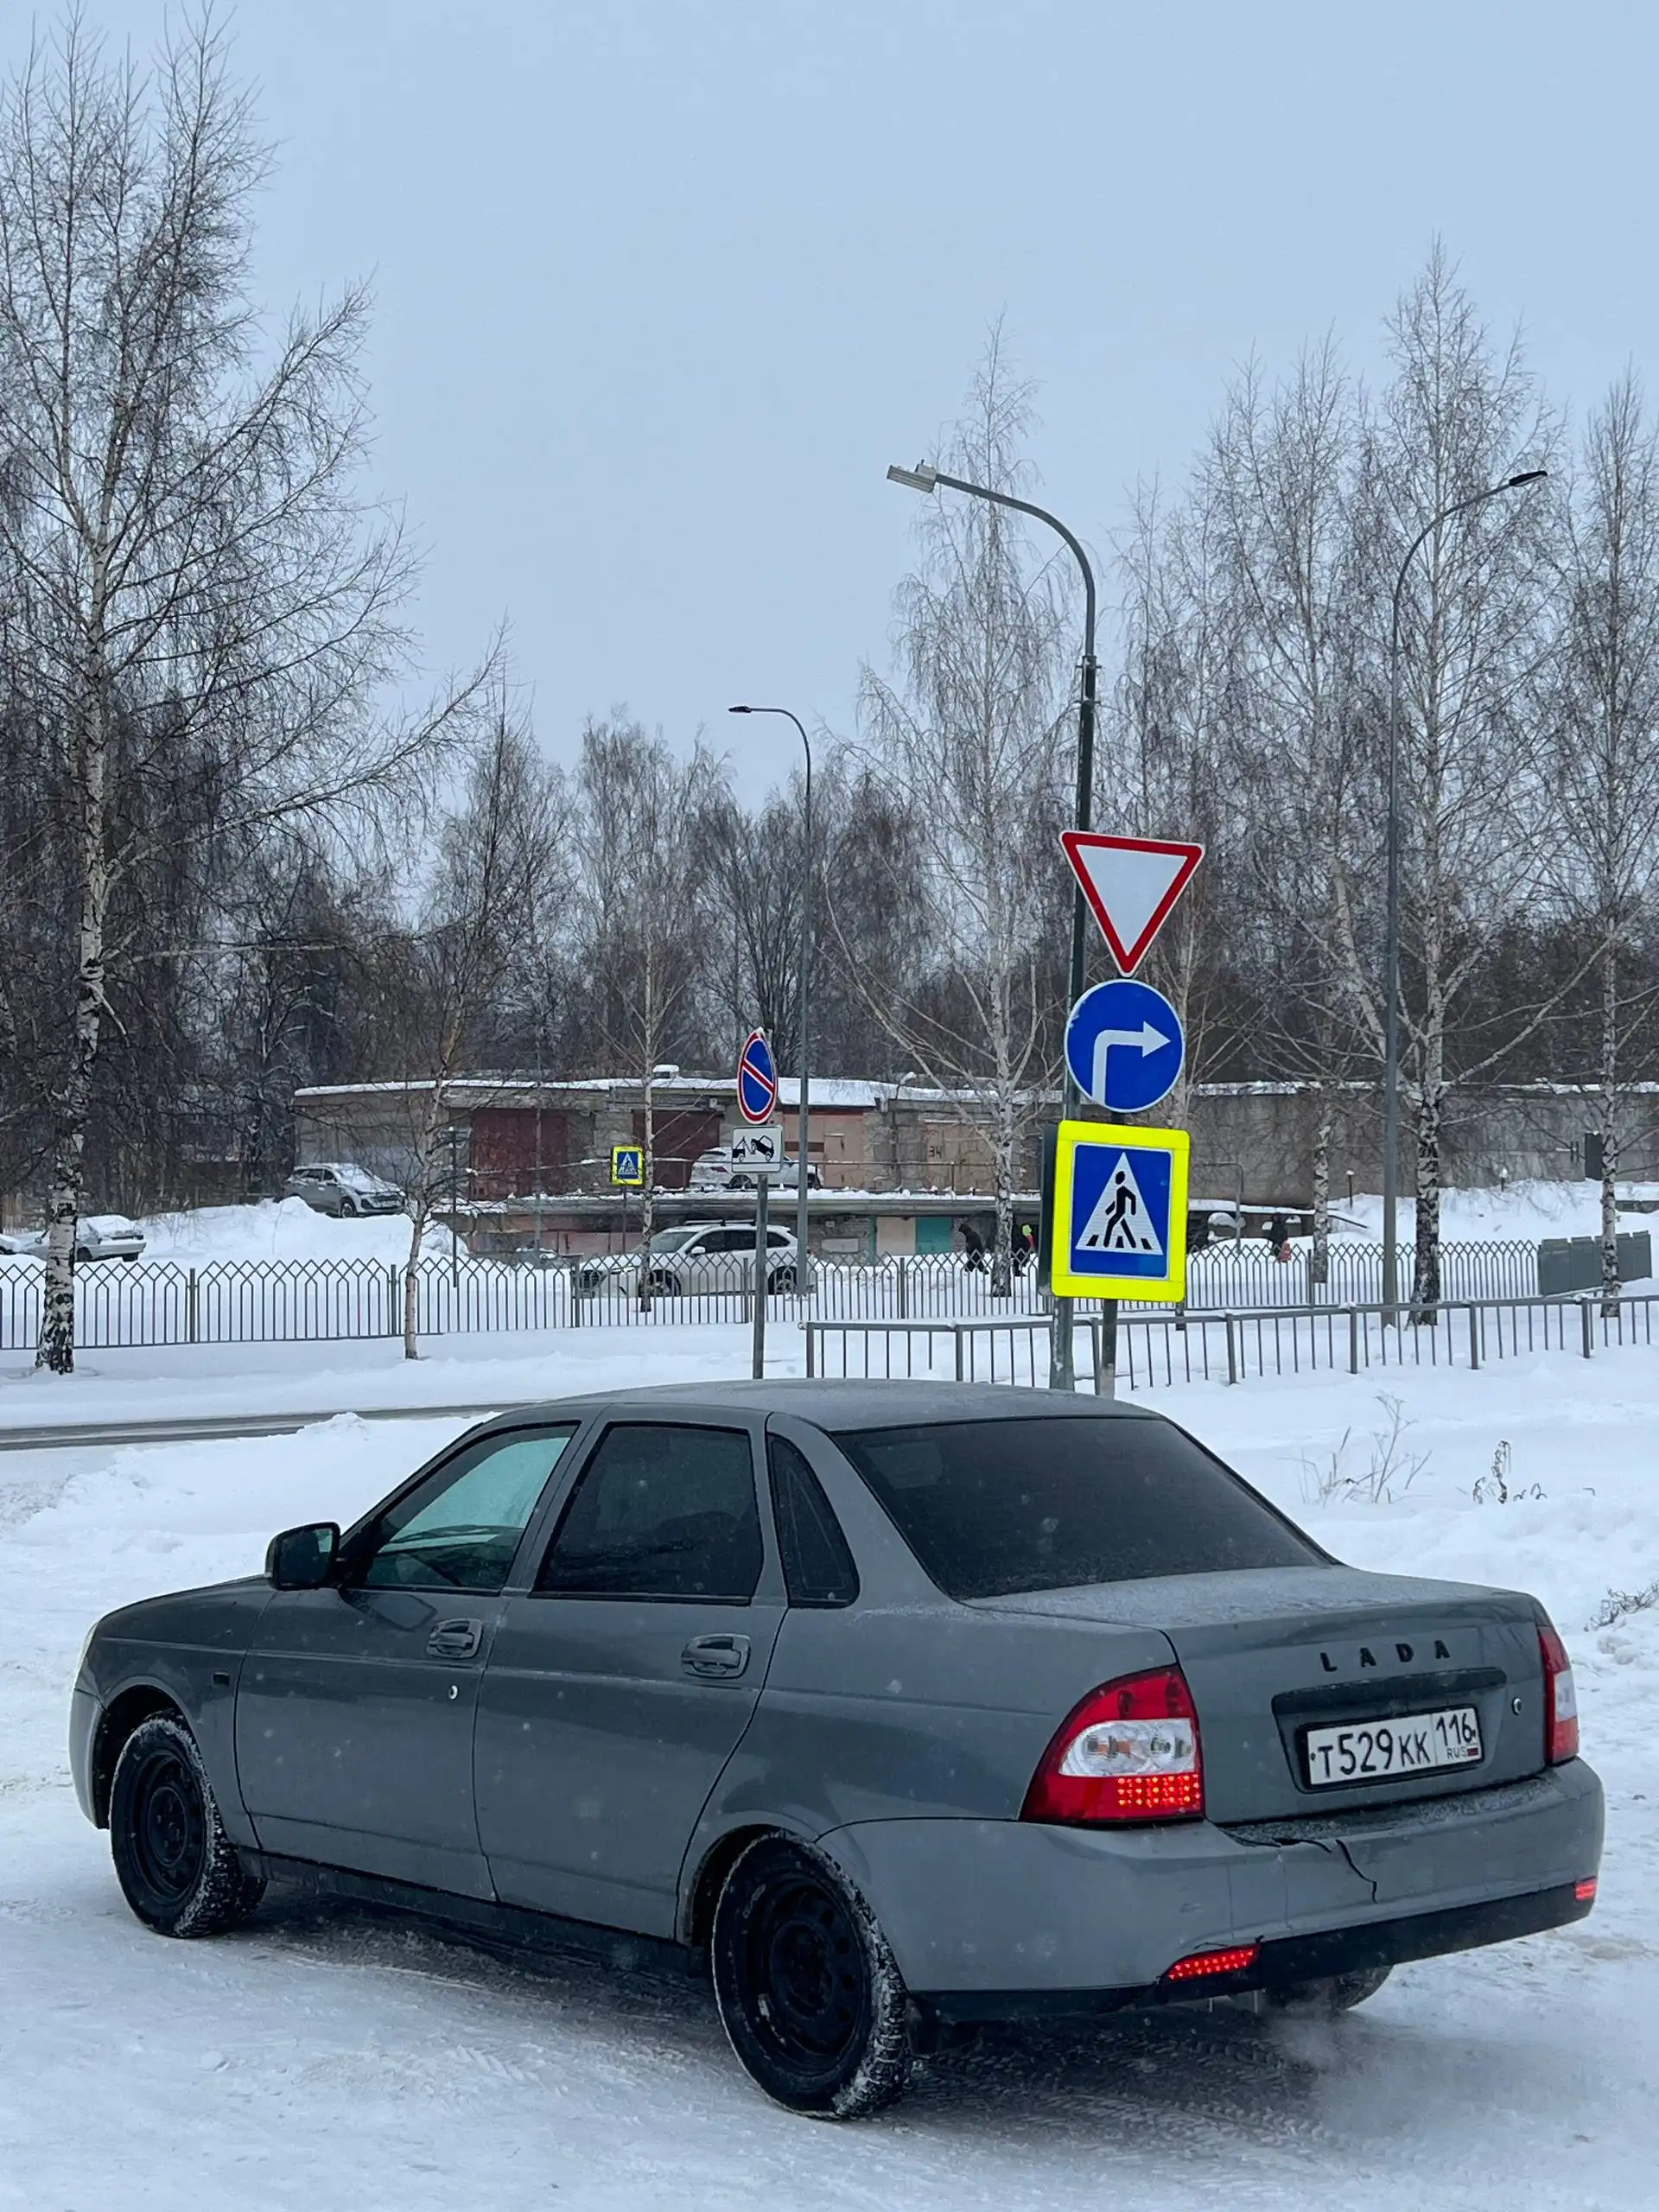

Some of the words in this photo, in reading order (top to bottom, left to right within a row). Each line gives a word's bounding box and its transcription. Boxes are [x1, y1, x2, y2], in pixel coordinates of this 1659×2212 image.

[1320, 1640, 1450, 1672] LADA
[1318, 1729, 1430, 1778] T529KK
[1436, 1713, 1474, 1746] 116
[1446, 1746, 1466, 1759] RUS
